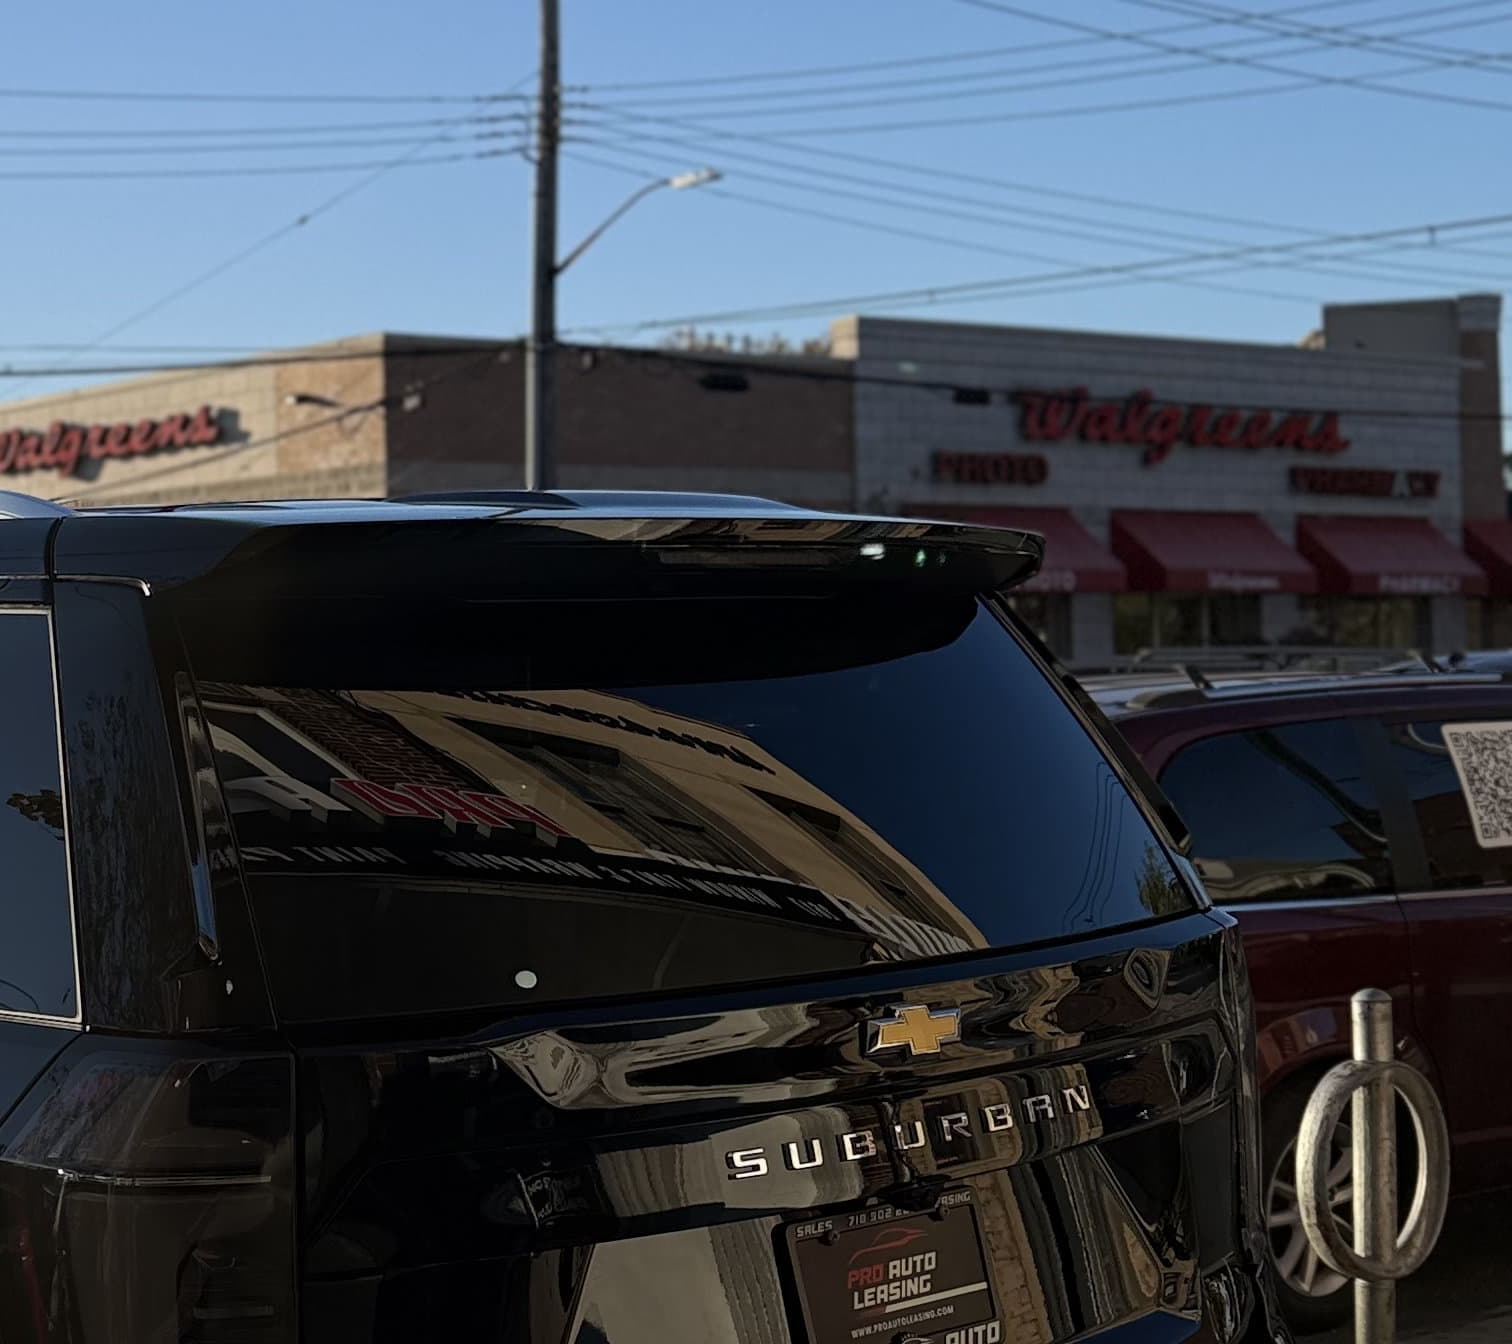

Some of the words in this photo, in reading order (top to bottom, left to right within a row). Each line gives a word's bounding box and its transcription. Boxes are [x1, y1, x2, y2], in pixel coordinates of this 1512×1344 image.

[1014, 387, 1350, 466] Walgreens
[933, 452, 1049, 486] PHOTO
[1018, 569, 1077, 592] HOTO
[729, 1085, 1090, 1181] SUBURBAN
[935, 1191, 971, 1209] ASING
[796, 1220, 833, 1238] SALES
[847, 1263, 885, 1290] PRO
[888, 1251, 937, 1280] AUTO
[853, 1273, 932, 1311] LEASING
